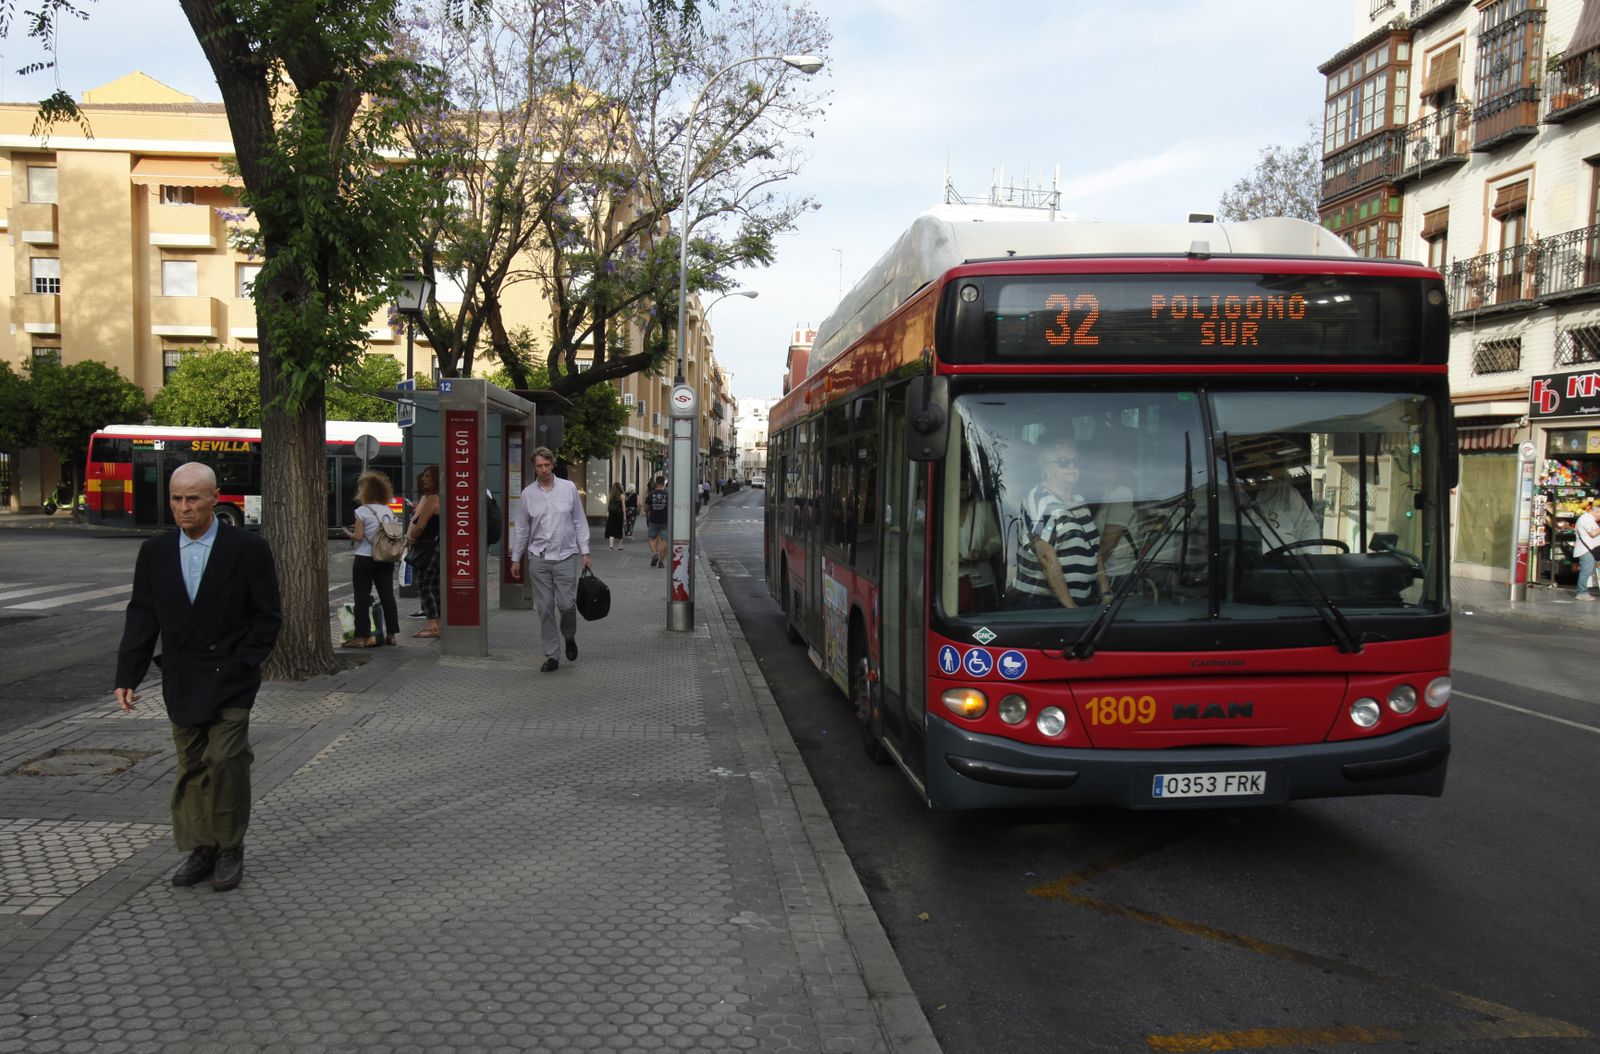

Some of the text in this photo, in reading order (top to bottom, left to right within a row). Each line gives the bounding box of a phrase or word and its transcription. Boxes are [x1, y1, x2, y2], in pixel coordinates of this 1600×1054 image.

[1045, 294, 1099, 345] 32
[1151, 294, 1305, 320] POLIGONO
[1201, 321, 1258, 346] SUR
[440, 382, 452, 392] 12
[191, 440, 251, 452] SEVILLA
[455, 430, 469, 464] LEON
[456, 471, 469, 488] DE
[456, 495, 470, 536] PONCE
[456, 543, 470, 576] PZA.
[1085, 695, 1157, 726] 1809
[1172, 702, 1253, 720] MAN
[1167, 776, 1217, 794] 0353
[1224, 774, 1262, 793] FRK
